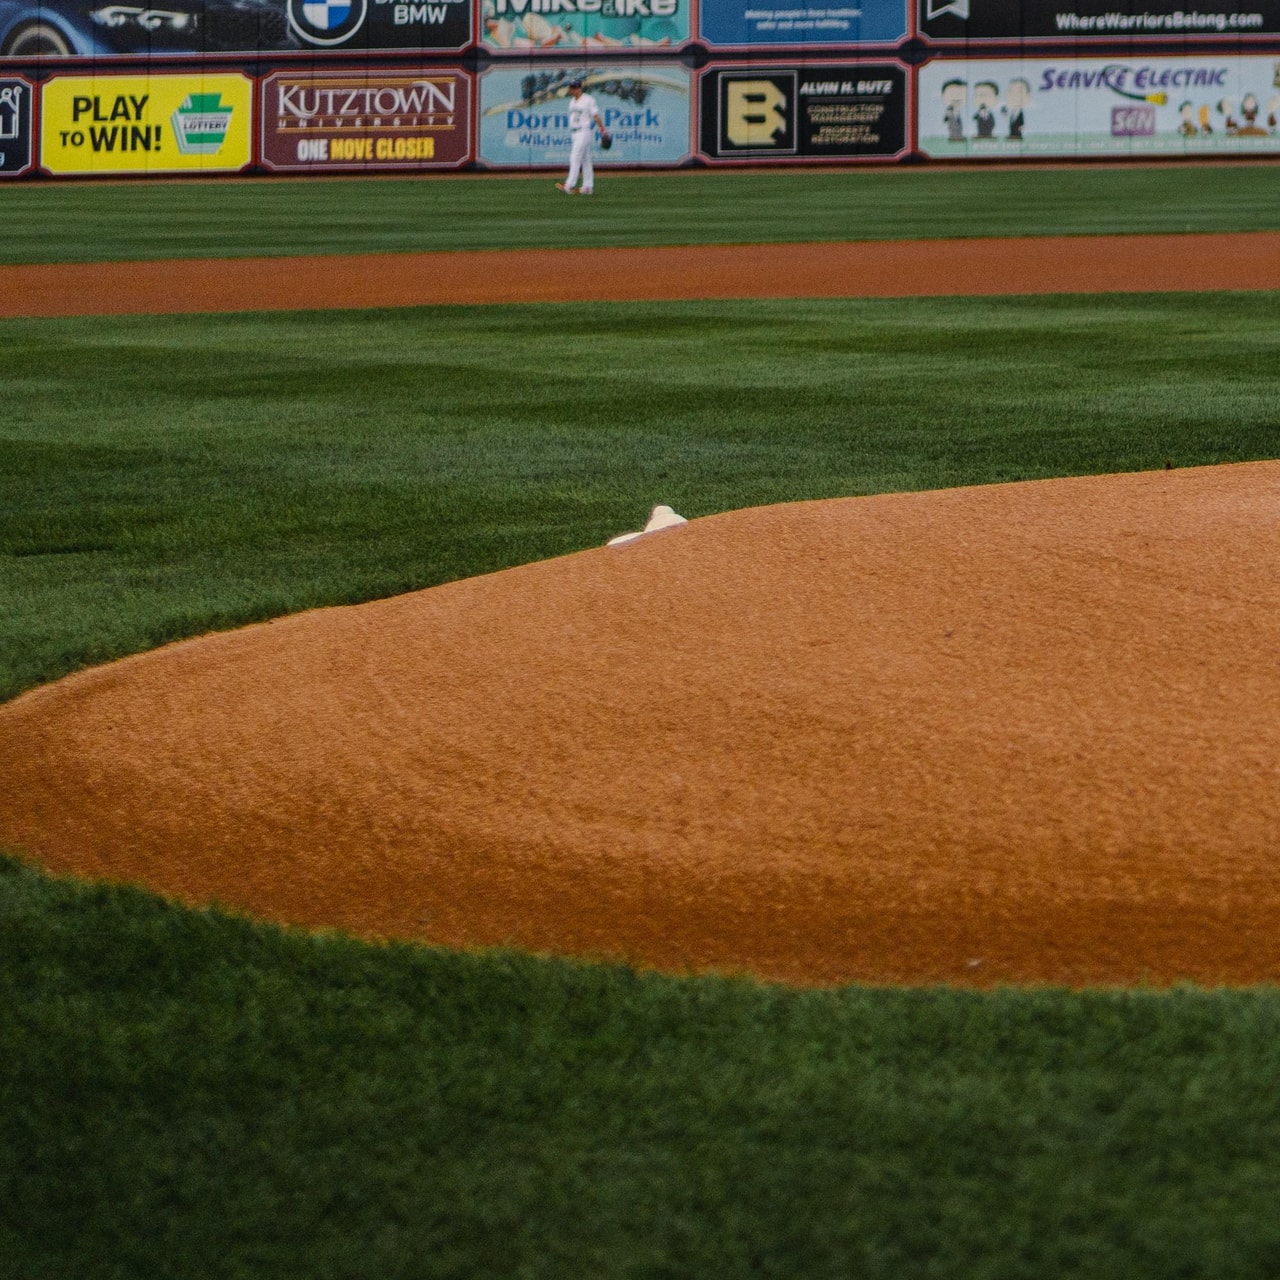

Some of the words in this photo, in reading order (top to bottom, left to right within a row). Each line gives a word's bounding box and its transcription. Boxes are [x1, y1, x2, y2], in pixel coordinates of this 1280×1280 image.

[393, 4, 448, 25] BMW
[800, 81, 839, 95] ALVIN
[857, 80, 893, 94] BUTZ
[1039, 68, 1129, 92] SERVICE
[1134, 66, 1227, 89] ELECTRIC
[72, 94, 150, 123] PLAY
[278, 81, 457, 119] KUTZTOWN
[605, 108, 660, 128] Park
[60, 131, 84, 147] TO
[89, 125, 162, 152] WIN!
[297, 138, 328, 161] ONE
[330, 137, 373, 160] MOVE
[376, 136, 435, 160] CLOSER
